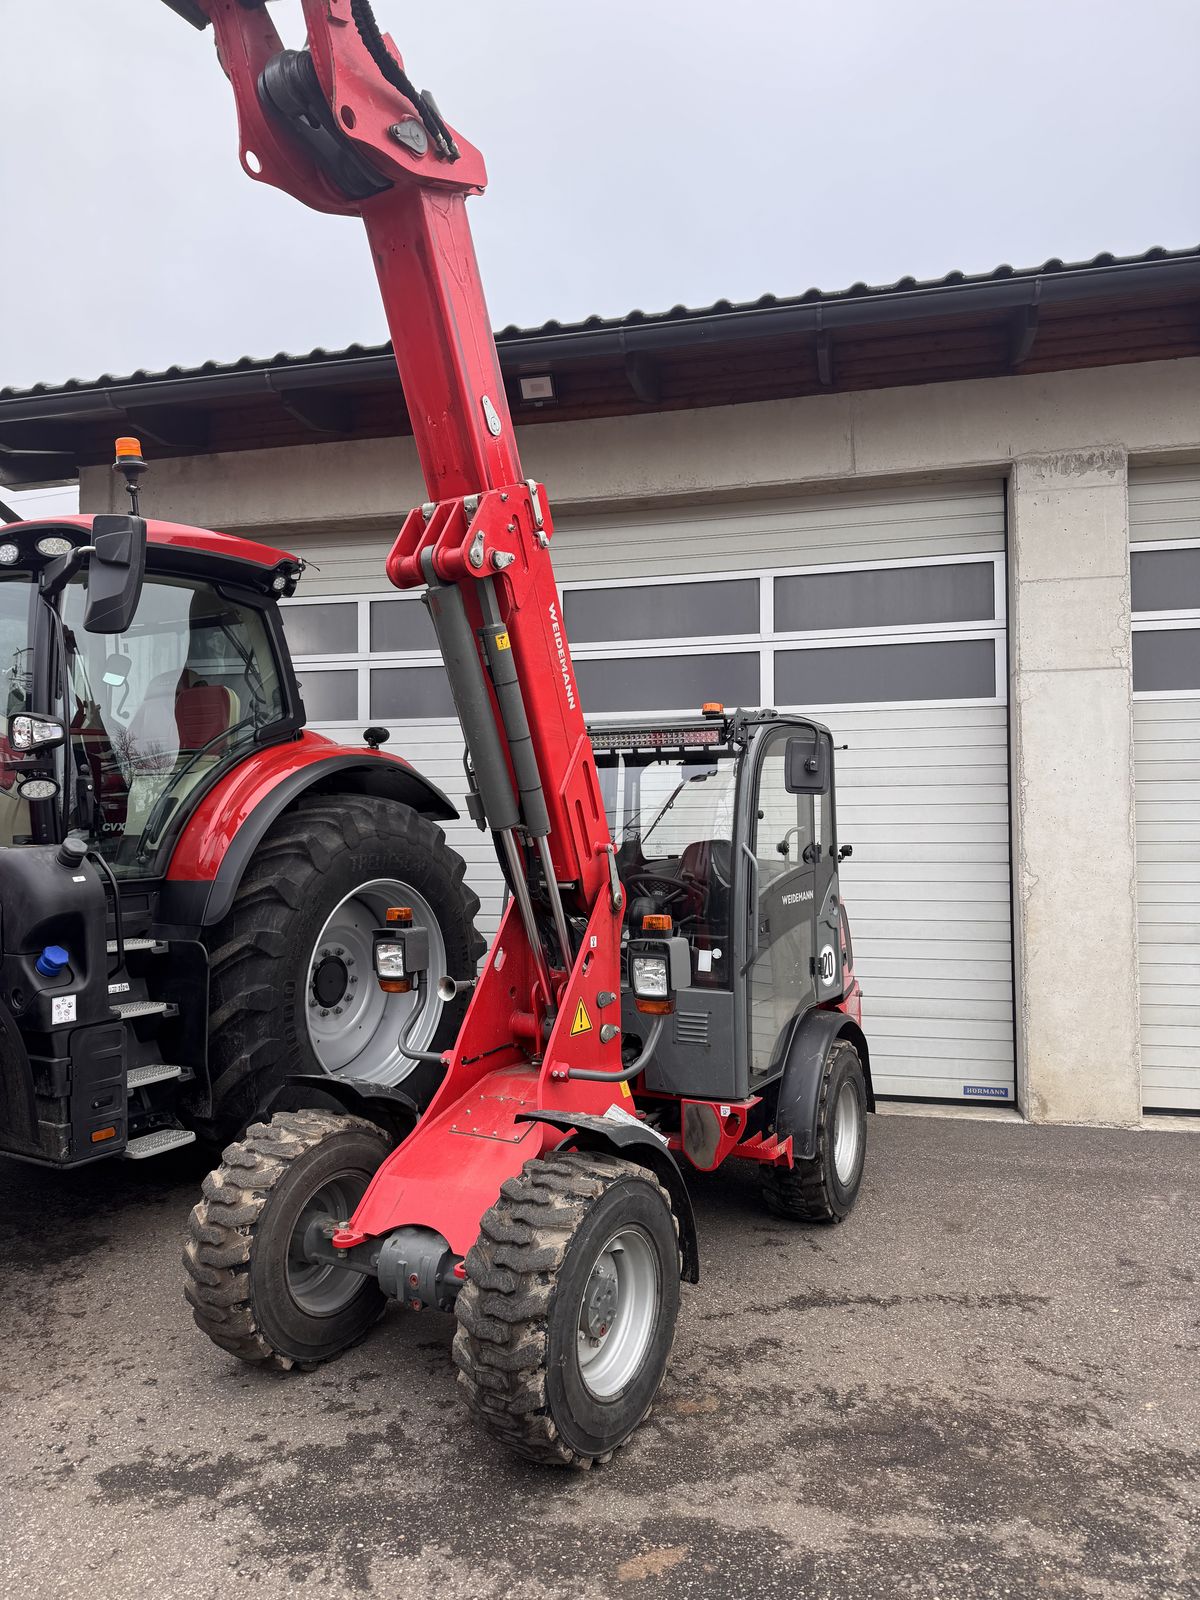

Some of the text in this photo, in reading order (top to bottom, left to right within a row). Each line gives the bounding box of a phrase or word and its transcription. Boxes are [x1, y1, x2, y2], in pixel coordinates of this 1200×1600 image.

[548, 601, 576, 710] WEIDEMANN
[781, 889, 814, 905] WEIDEMANN
[822, 951, 834, 979] 20
